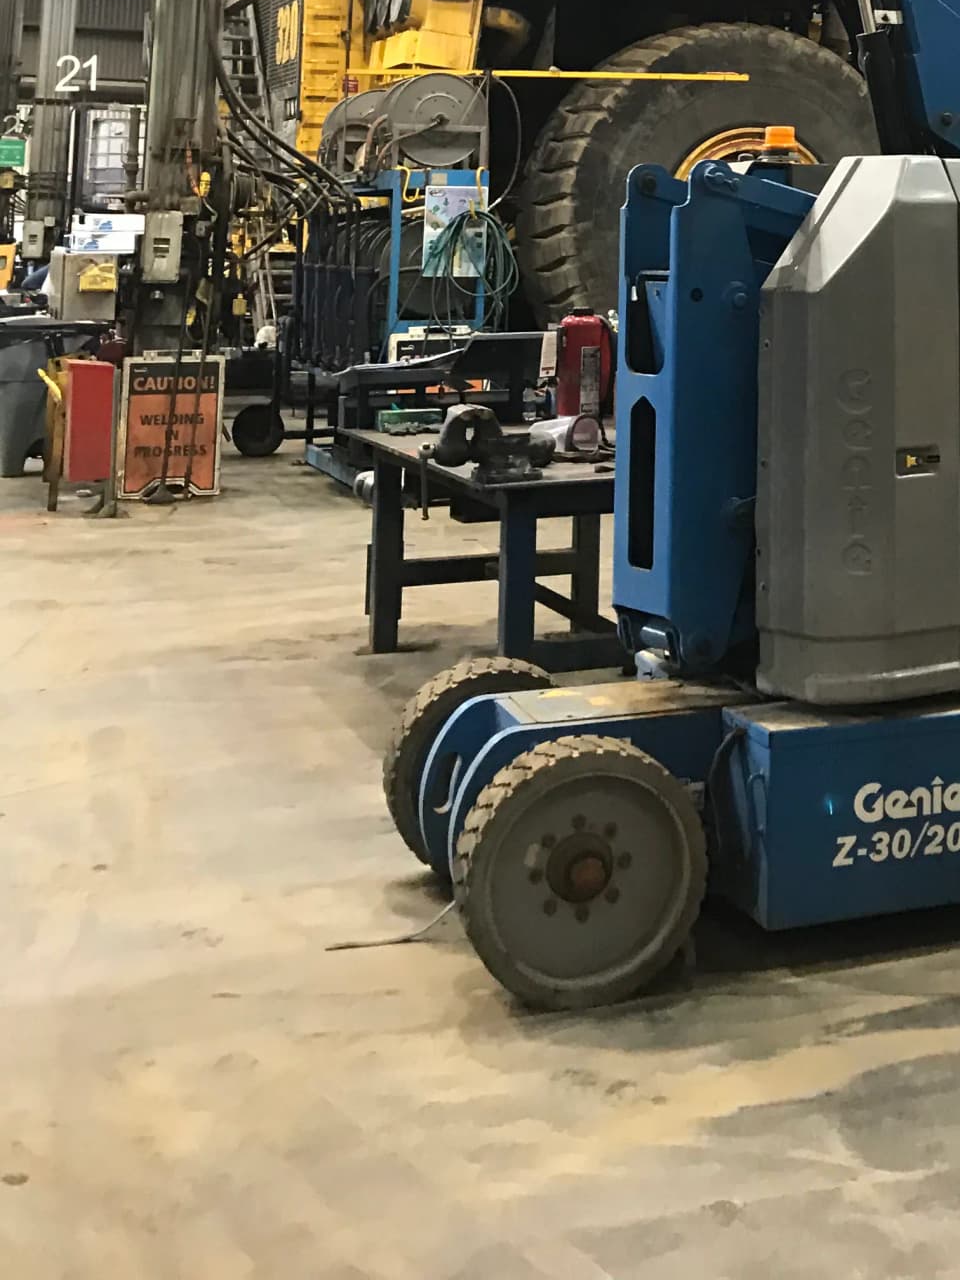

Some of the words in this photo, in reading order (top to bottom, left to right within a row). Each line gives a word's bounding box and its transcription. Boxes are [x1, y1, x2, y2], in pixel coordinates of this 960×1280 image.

[275, 0, 299, 65] 320
[54, 54, 98, 92] 21
[133, 376, 215, 391] CAUTION!
[140, 413, 204, 426] WELDING
[134, 444, 207, 458] PROGRESS
